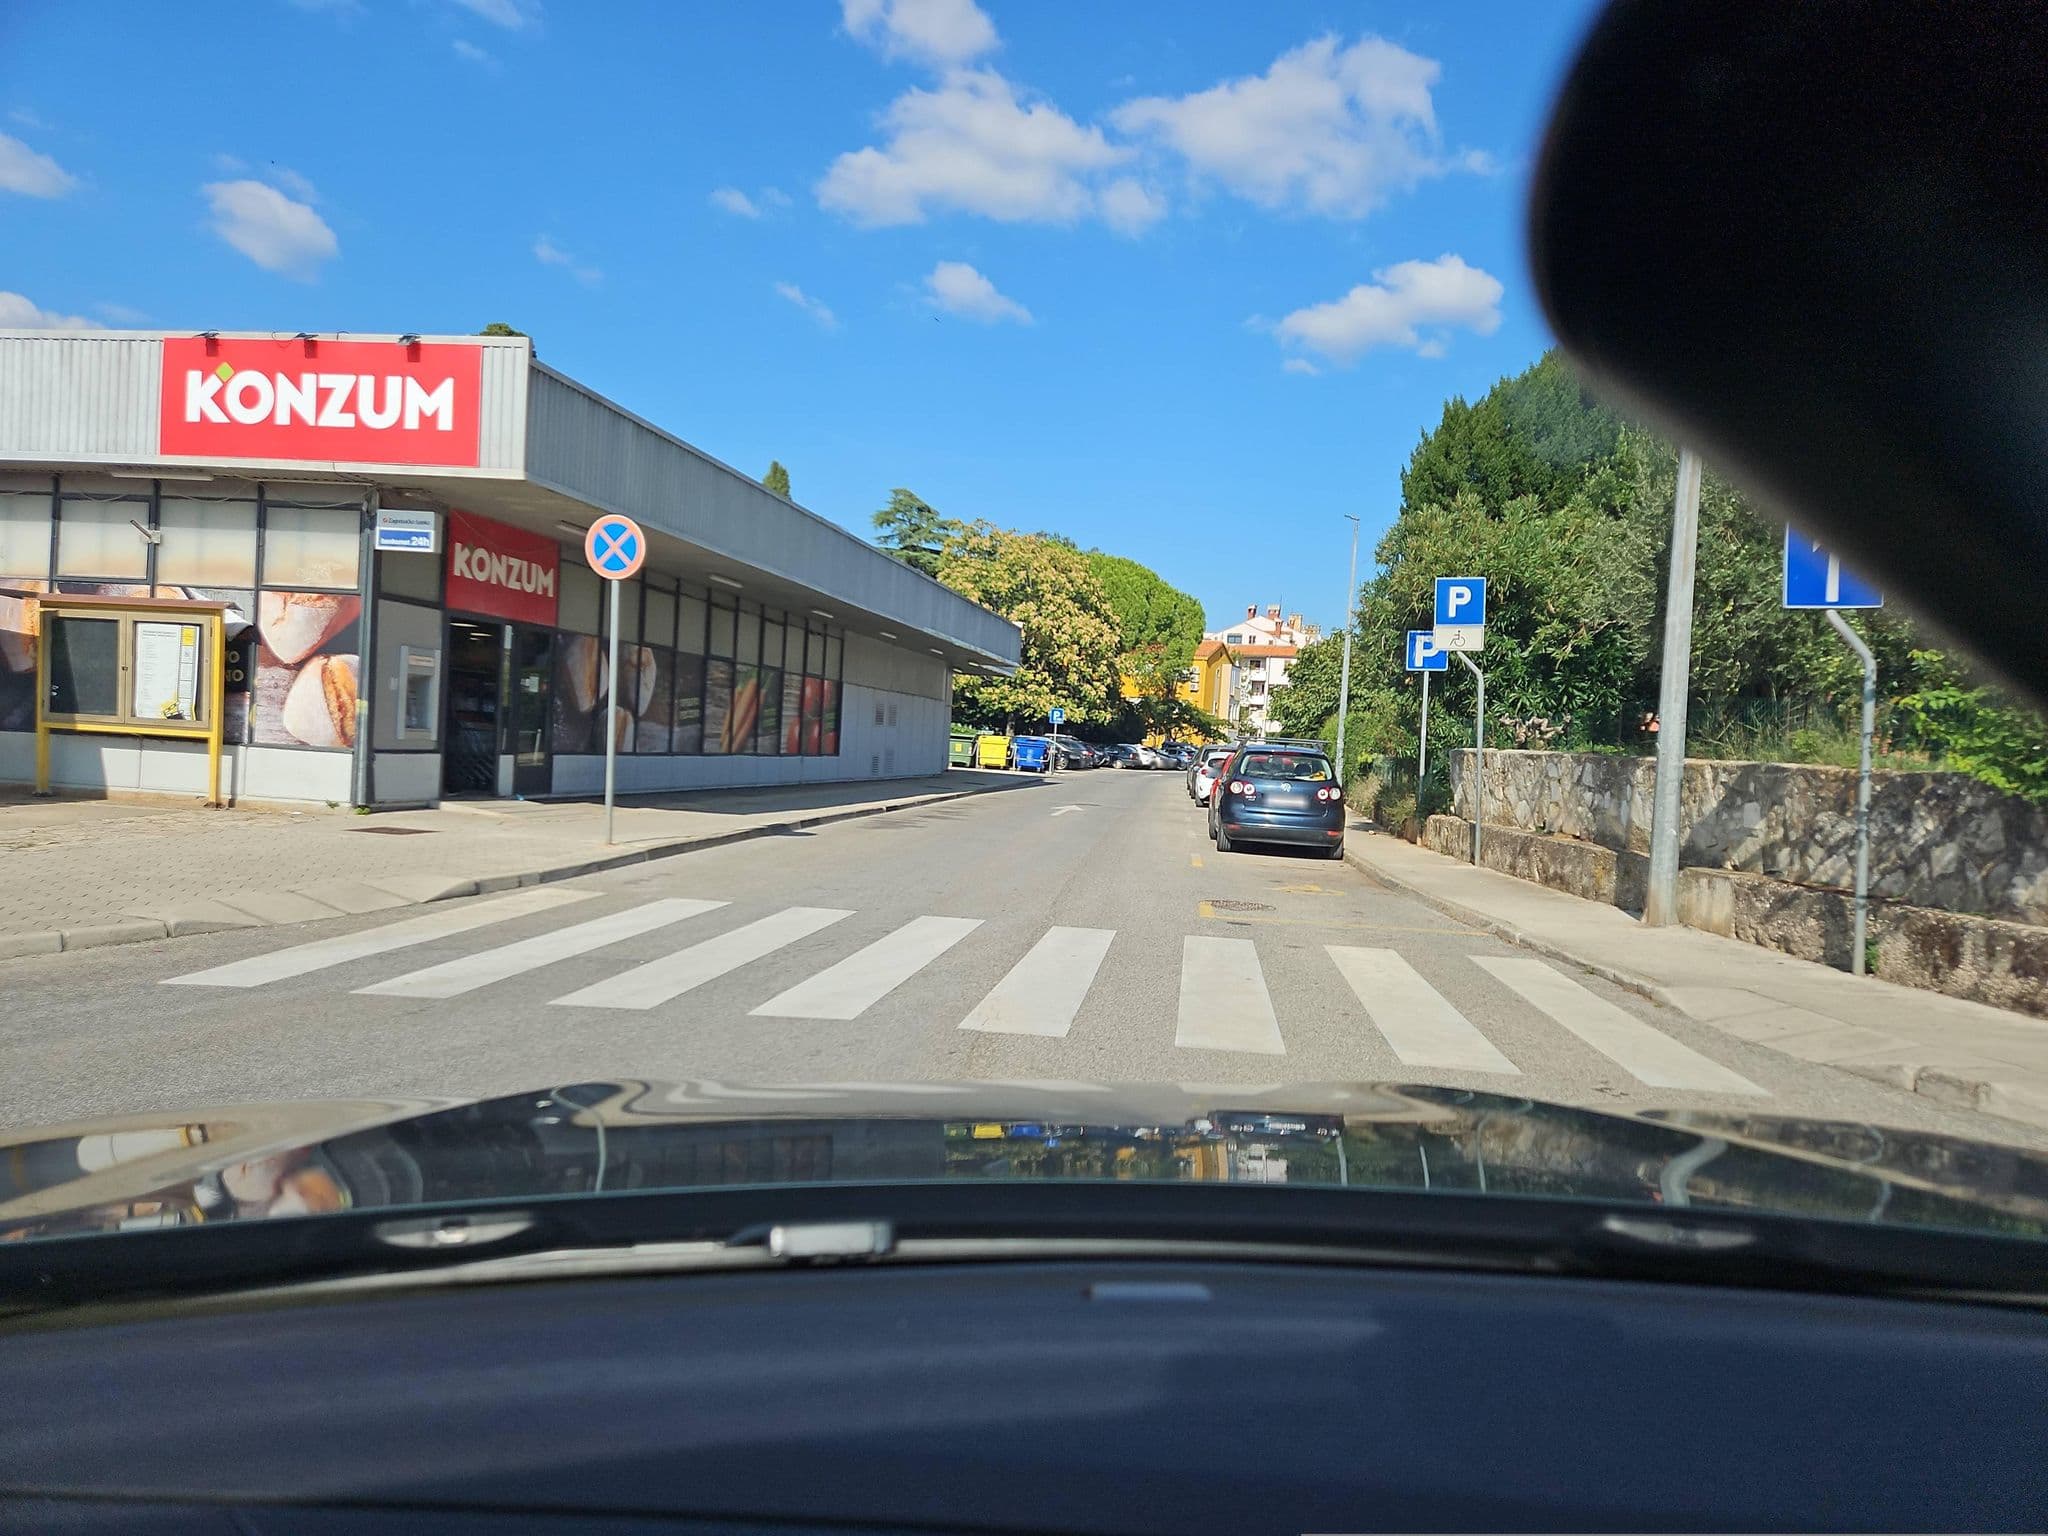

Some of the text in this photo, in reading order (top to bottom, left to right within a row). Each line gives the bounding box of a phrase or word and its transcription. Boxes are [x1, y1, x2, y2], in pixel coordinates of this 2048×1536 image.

[185, 368, 454, 431] KONZUM
[454, 542, 554, 598] KONZUM
[1448, 586, 1472, 618] P
[1414, 635, 1439, 667] P
[1053, 710, 1062, 721] P
